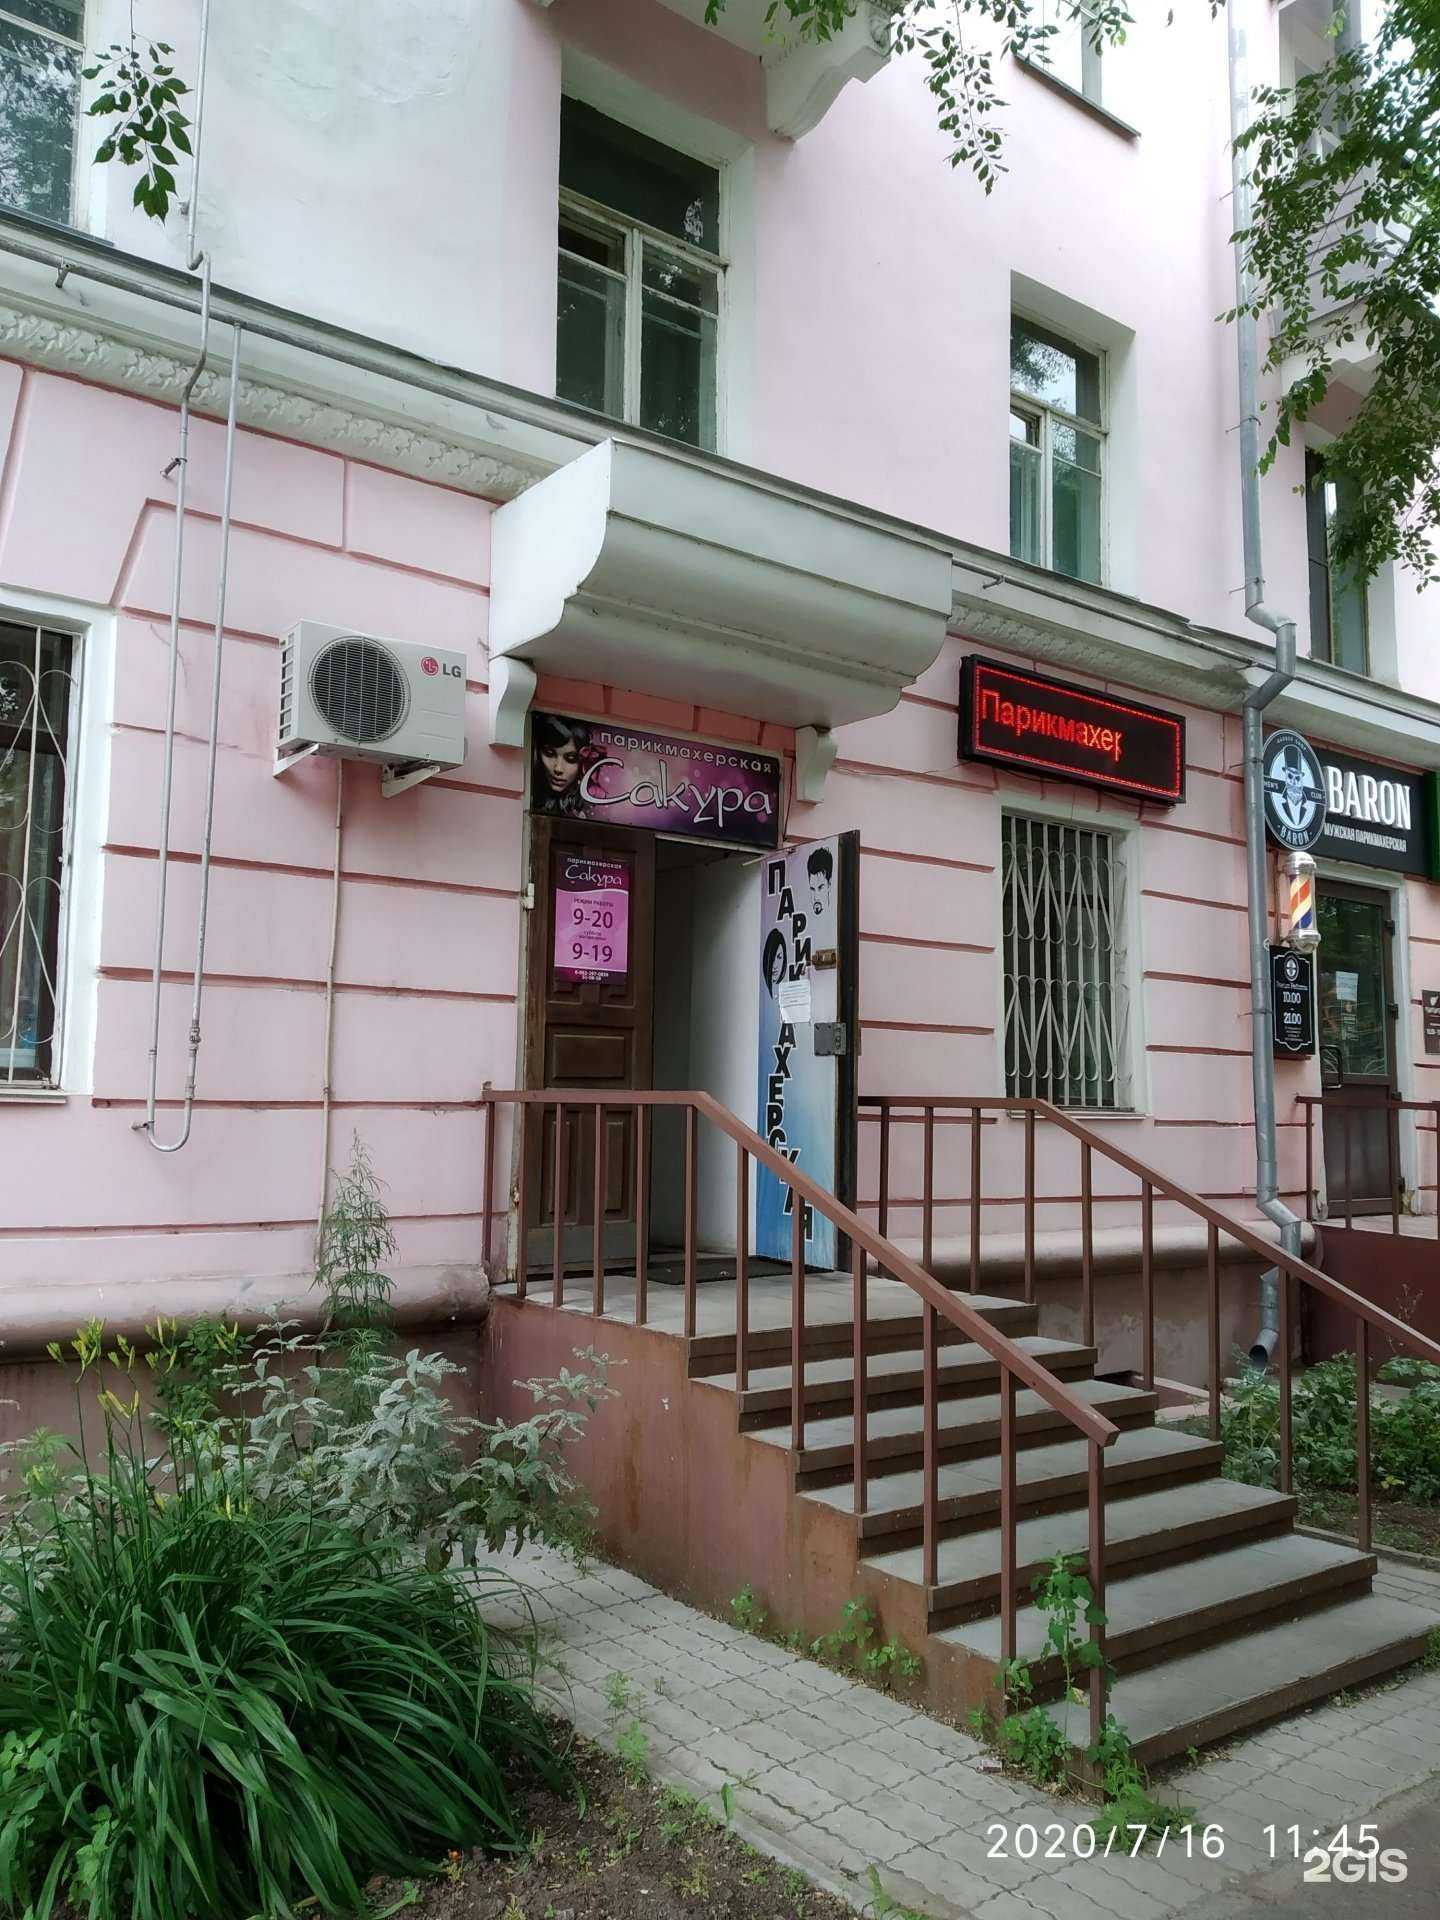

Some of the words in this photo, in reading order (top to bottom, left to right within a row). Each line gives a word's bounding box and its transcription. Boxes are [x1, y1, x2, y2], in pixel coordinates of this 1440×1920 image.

[442, 663, 462, 678] LG
[599, 730, 772, 774] парикмахерская
[578, 757, 773, 828] Сакура
[1323, 765, 1411, 831] BARON
[1280, 825, 1310, 846] BARON
[565, 864, 623, 889] Сакура
[572, 907, 614, 929] 9-20
[571, 942, 614, 963] 9-19
